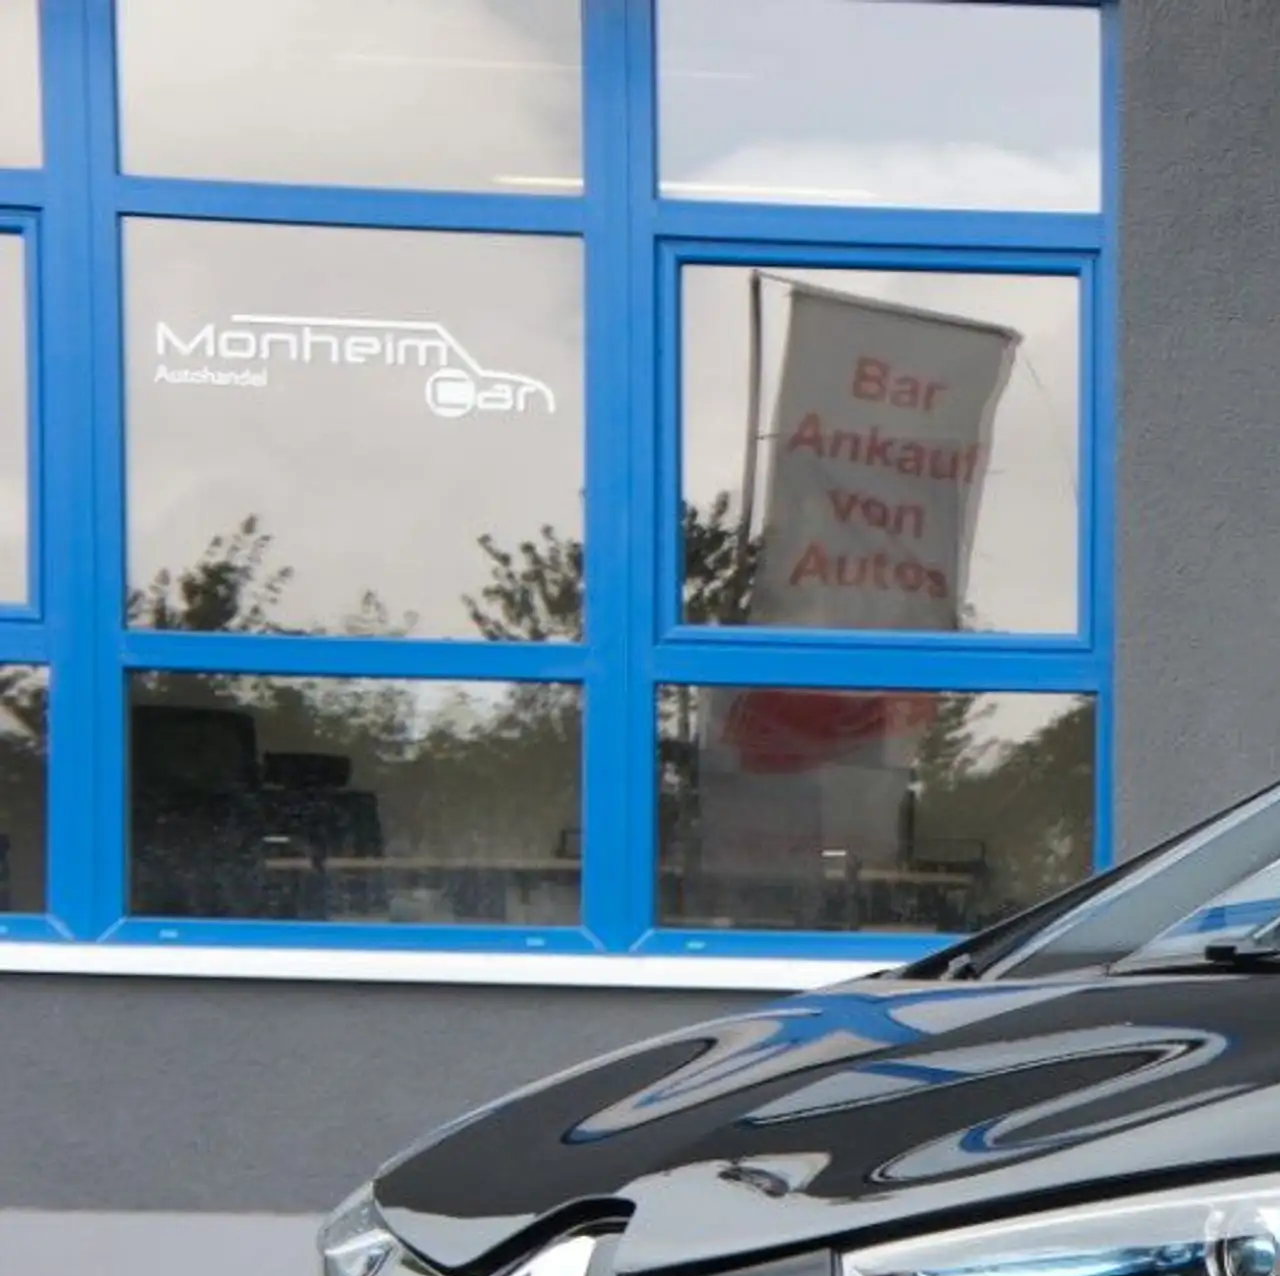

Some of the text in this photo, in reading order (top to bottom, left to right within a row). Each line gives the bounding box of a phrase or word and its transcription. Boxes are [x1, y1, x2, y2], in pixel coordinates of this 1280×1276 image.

[155, 321, 448, 367] Monheim
[154, 364, 268, 388] Autohandel
[852, 356, 949, 411] Bar
[786, 411, 982, 484] Ankauf
[827, 488, 925, 539] von
[789, 541, 948, 599] Autos
